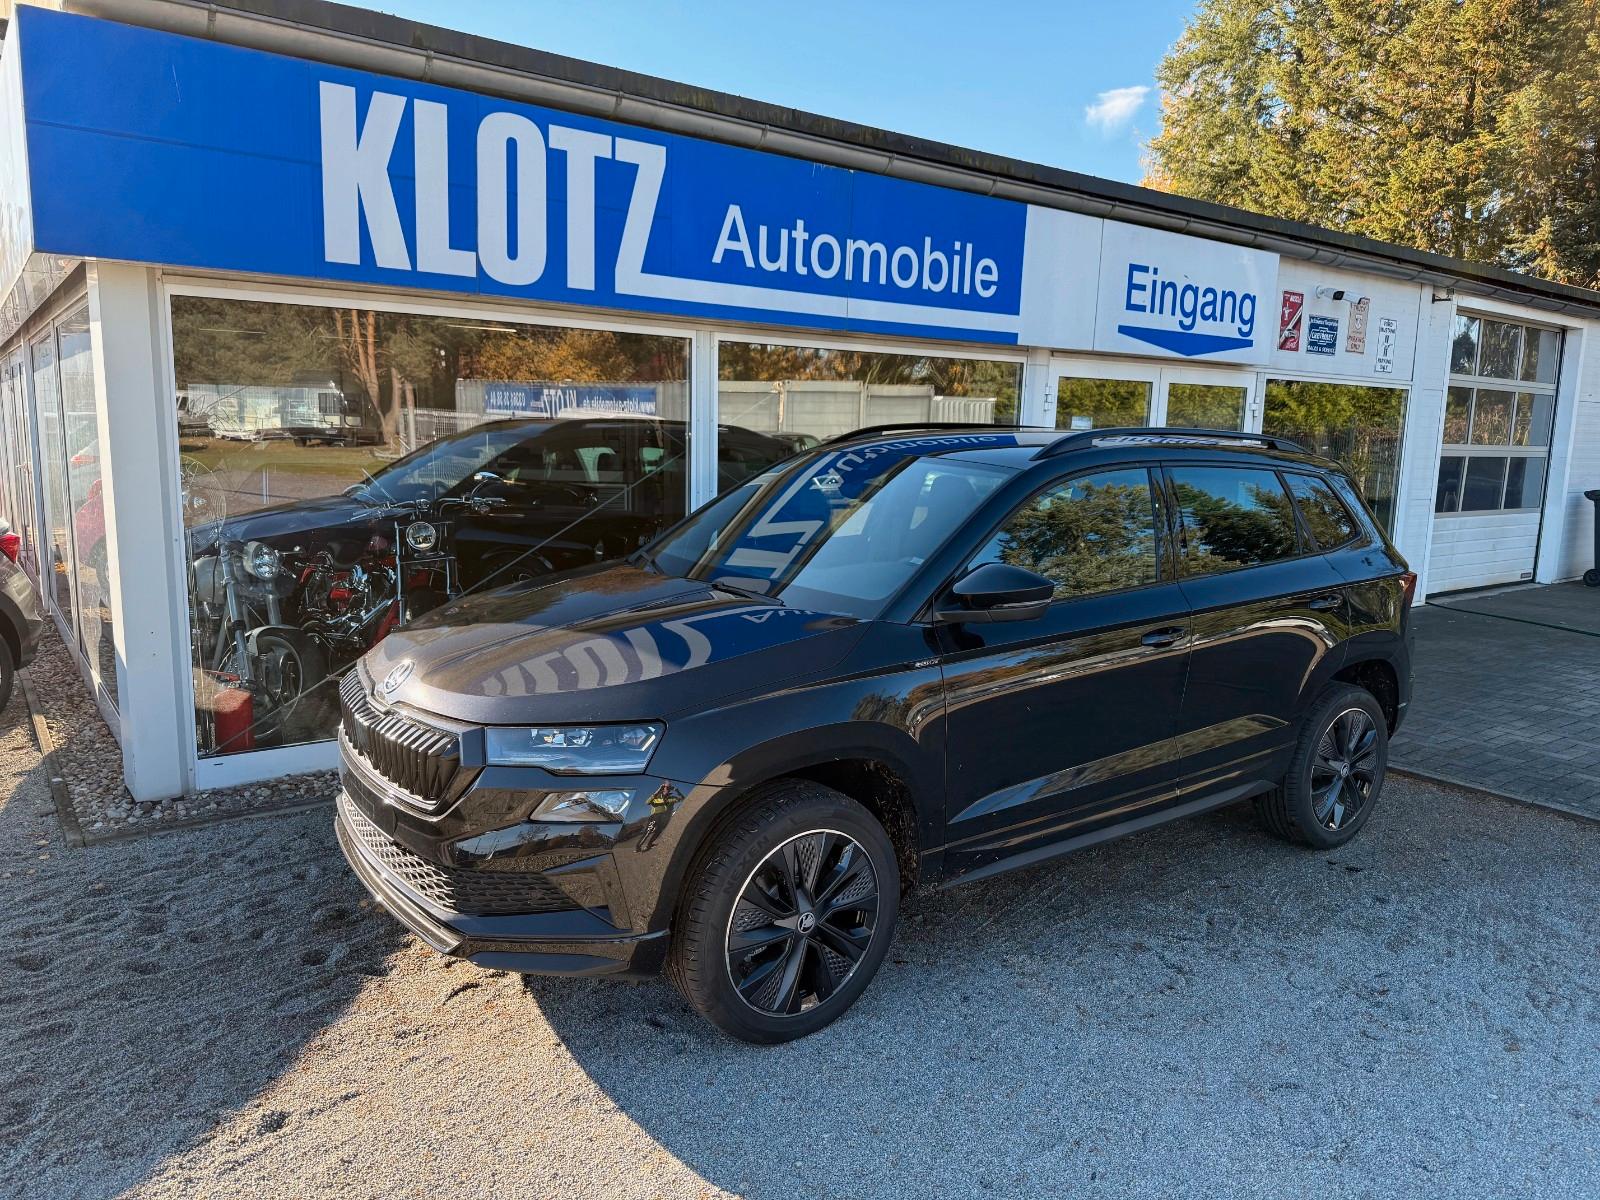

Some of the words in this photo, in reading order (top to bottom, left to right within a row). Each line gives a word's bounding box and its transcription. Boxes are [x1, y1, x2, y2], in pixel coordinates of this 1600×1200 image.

[320, 80, 667, 294] KLOTZ
[712, 204, 999, 298] Automobile
[1125, 262, 1257, 338] Eingang
